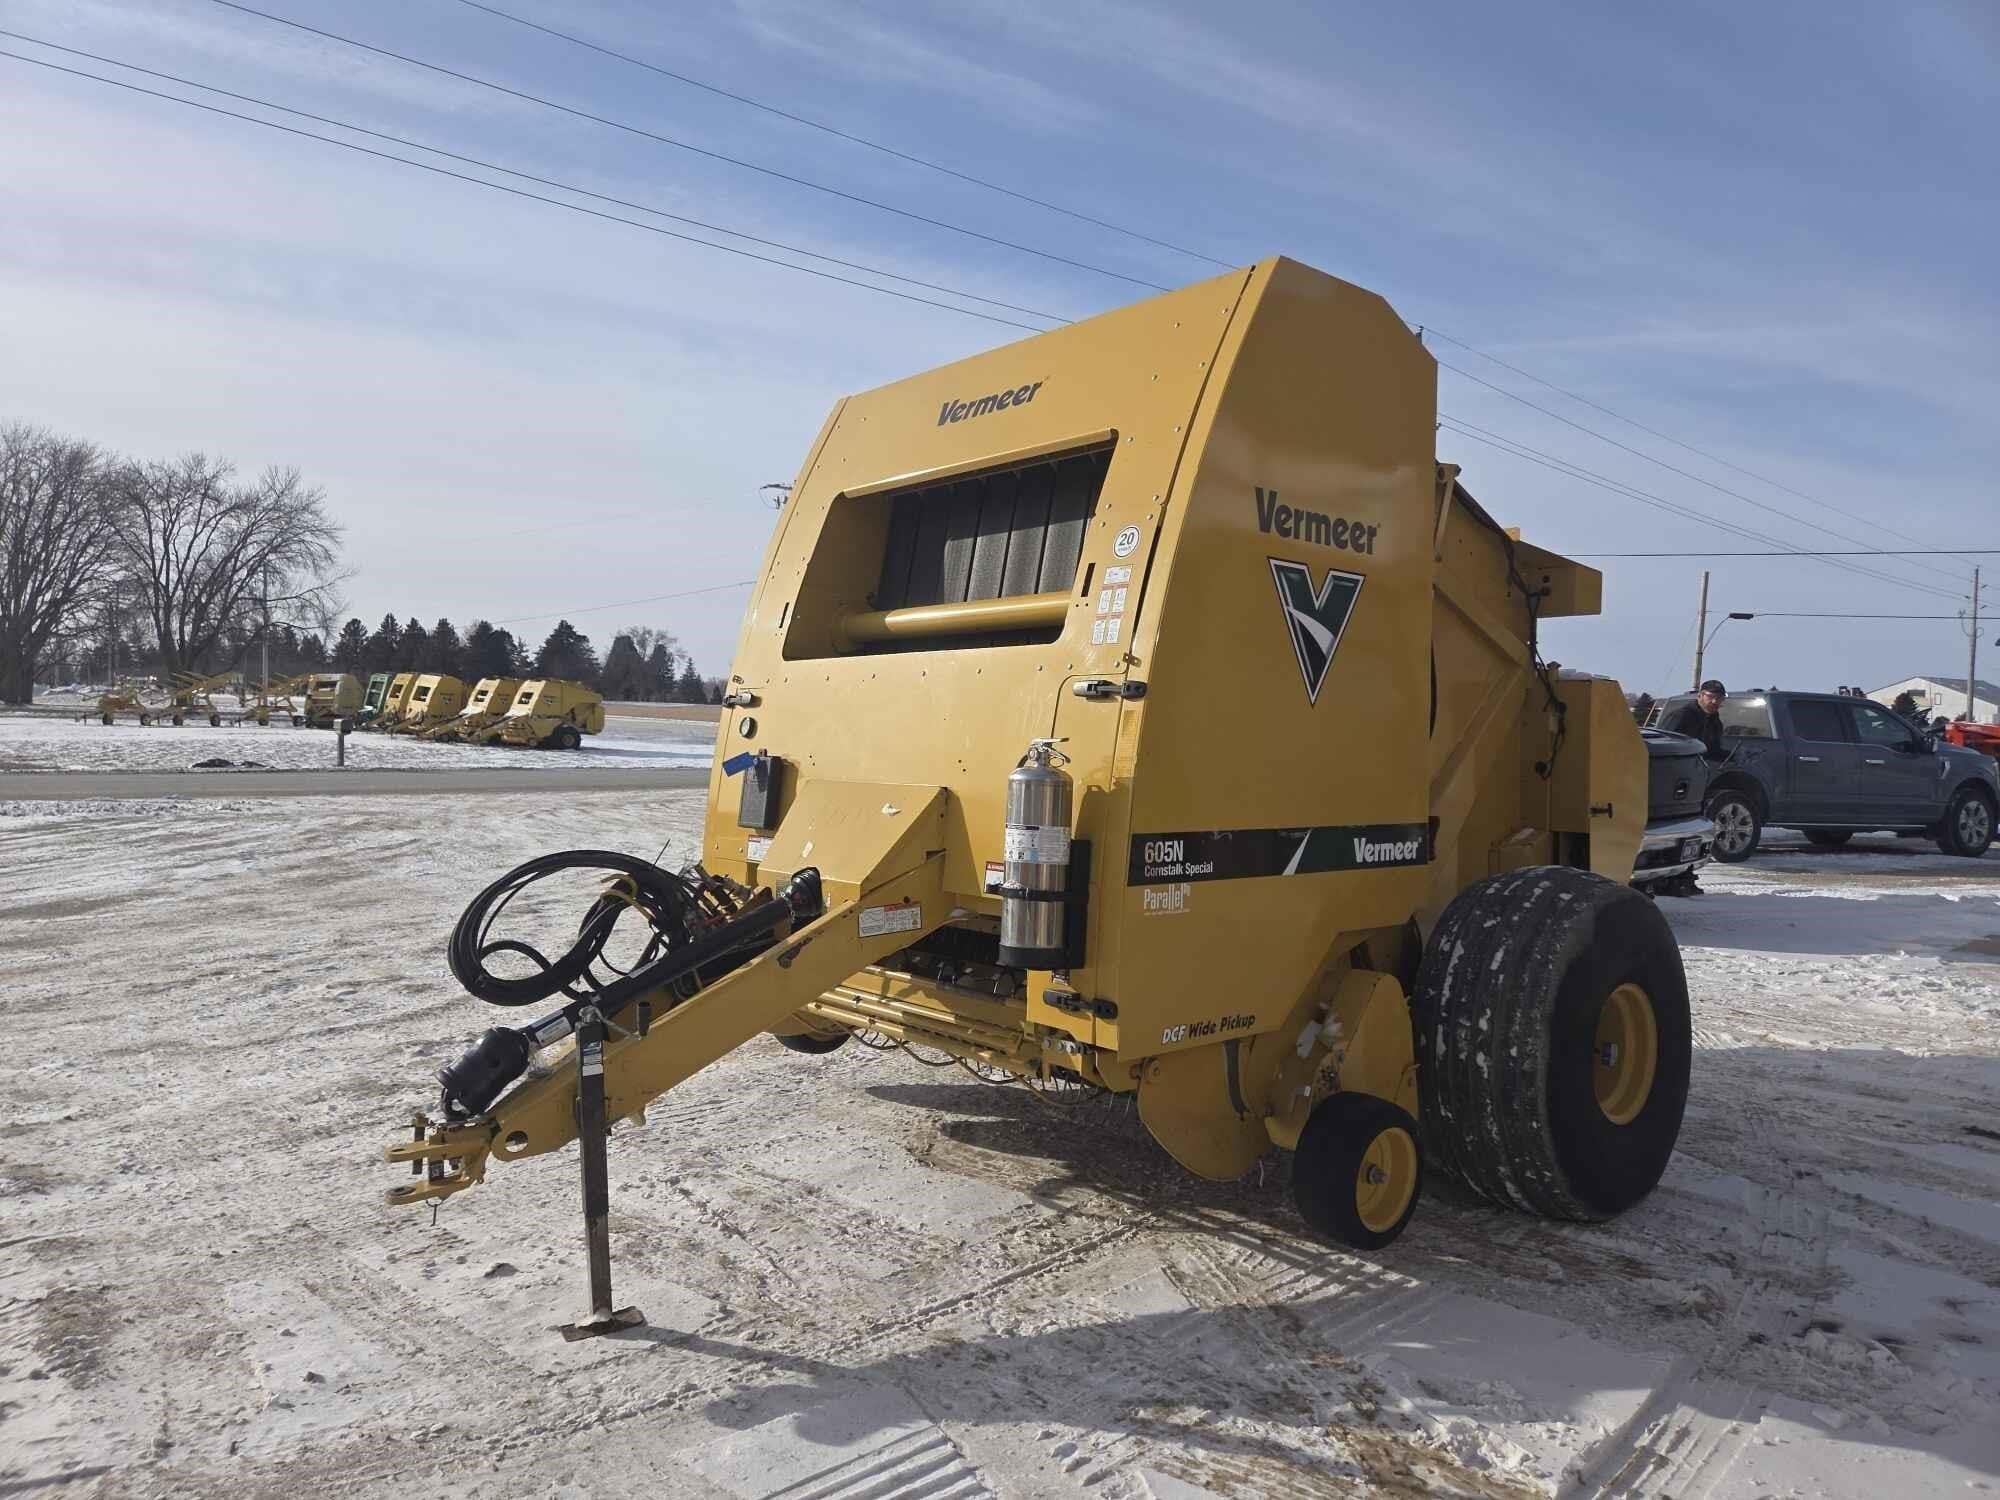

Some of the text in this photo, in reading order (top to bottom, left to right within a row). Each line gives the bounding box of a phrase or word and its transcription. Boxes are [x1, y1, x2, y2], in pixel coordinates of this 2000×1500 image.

[937, 382, 1043, 426] Vermeer
[1254, 486, 1377, 555] Vermeer
[1118, 532, 1135, 546] 20
[1144, 839, 1184, 863] 605N
[1353, 837, 1419, 863] Vermeer
[1144, 860, 1213, 877] Cornstalk Special
[1143, 883, 1185, 912] Parallel
[1188, 1020, 1216, 1039] Wide
[1220, 1014, 1256, 1032] Pickup
